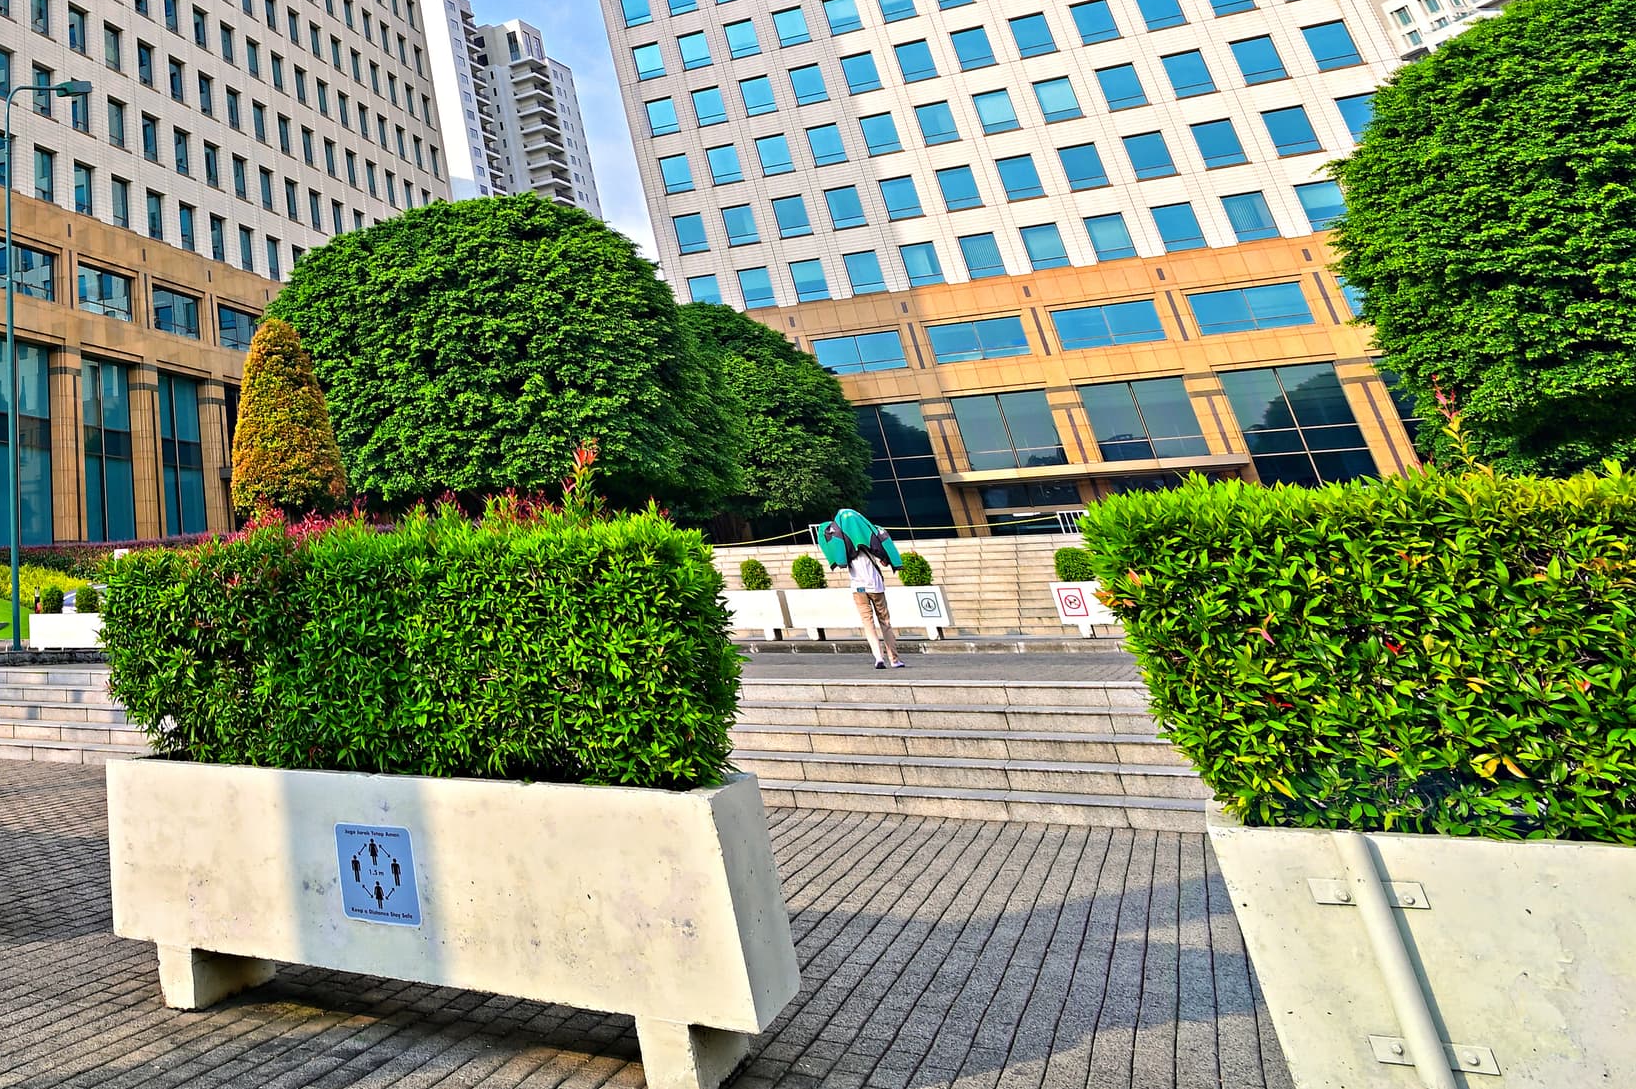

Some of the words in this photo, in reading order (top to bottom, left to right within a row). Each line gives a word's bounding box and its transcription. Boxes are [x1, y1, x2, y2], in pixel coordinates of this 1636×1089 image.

[369, 909, 389, 917] Distance
[390, 911, 401, 919] Stay
[401, 912, 413, 920] Safe
